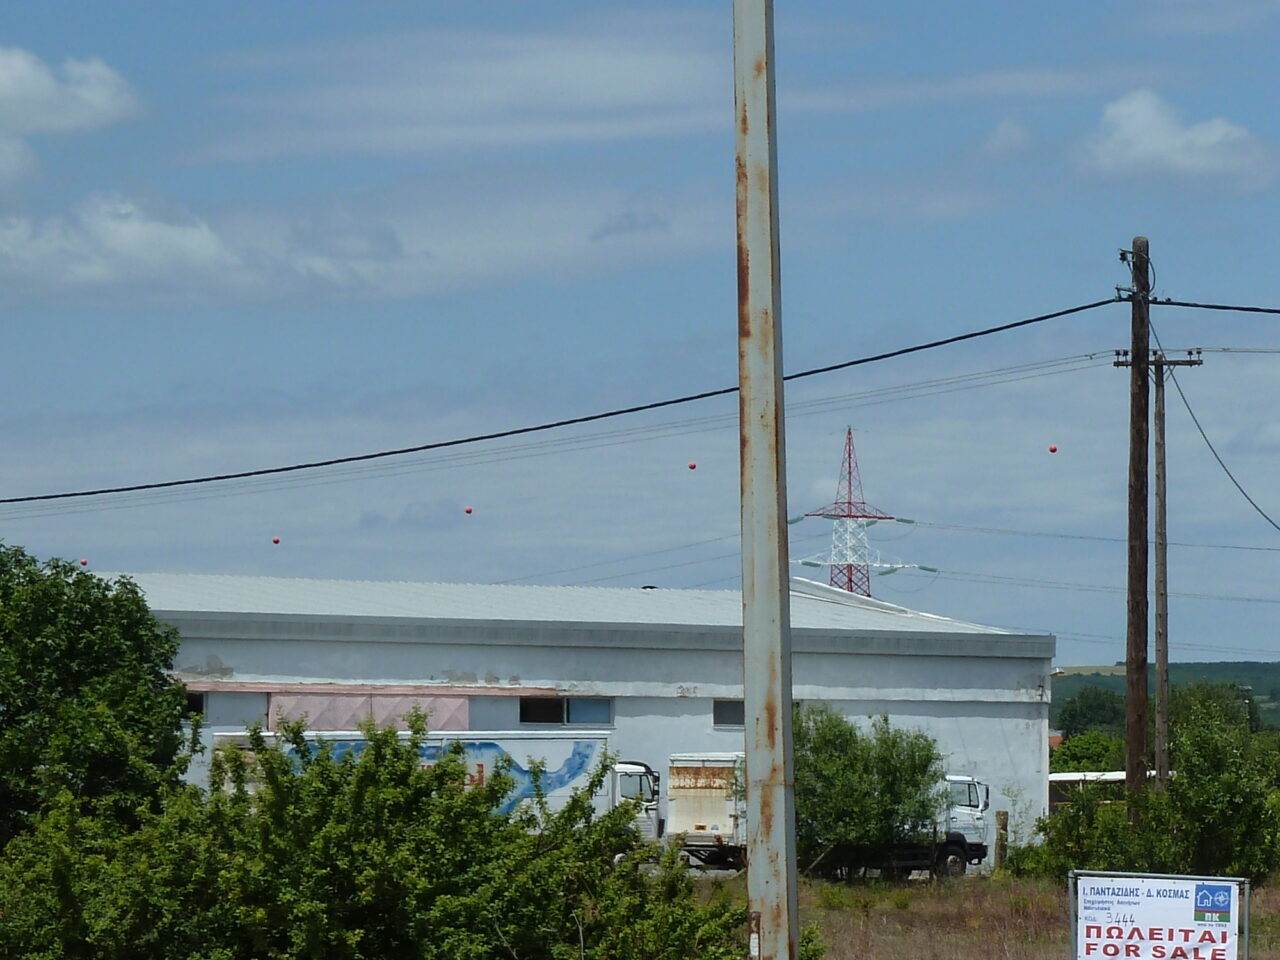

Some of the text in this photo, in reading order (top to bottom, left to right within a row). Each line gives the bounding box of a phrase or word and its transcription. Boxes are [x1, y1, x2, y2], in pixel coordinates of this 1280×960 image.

[1090, 887, 1140, 897] ΠΑΝΤΑΖΙΔΗΣ
[1156, 889, 1190, 899] ΚΟΣΜΑΣ
[1106, 912, 1135, 927] 3444
[1205, 913, 1219, 922] ΠΚ
[1085, 925, 1227, 944] ΠΩΛΕΙΤΑΙ
[1085, 943, 1226, 960] FOR SALE
